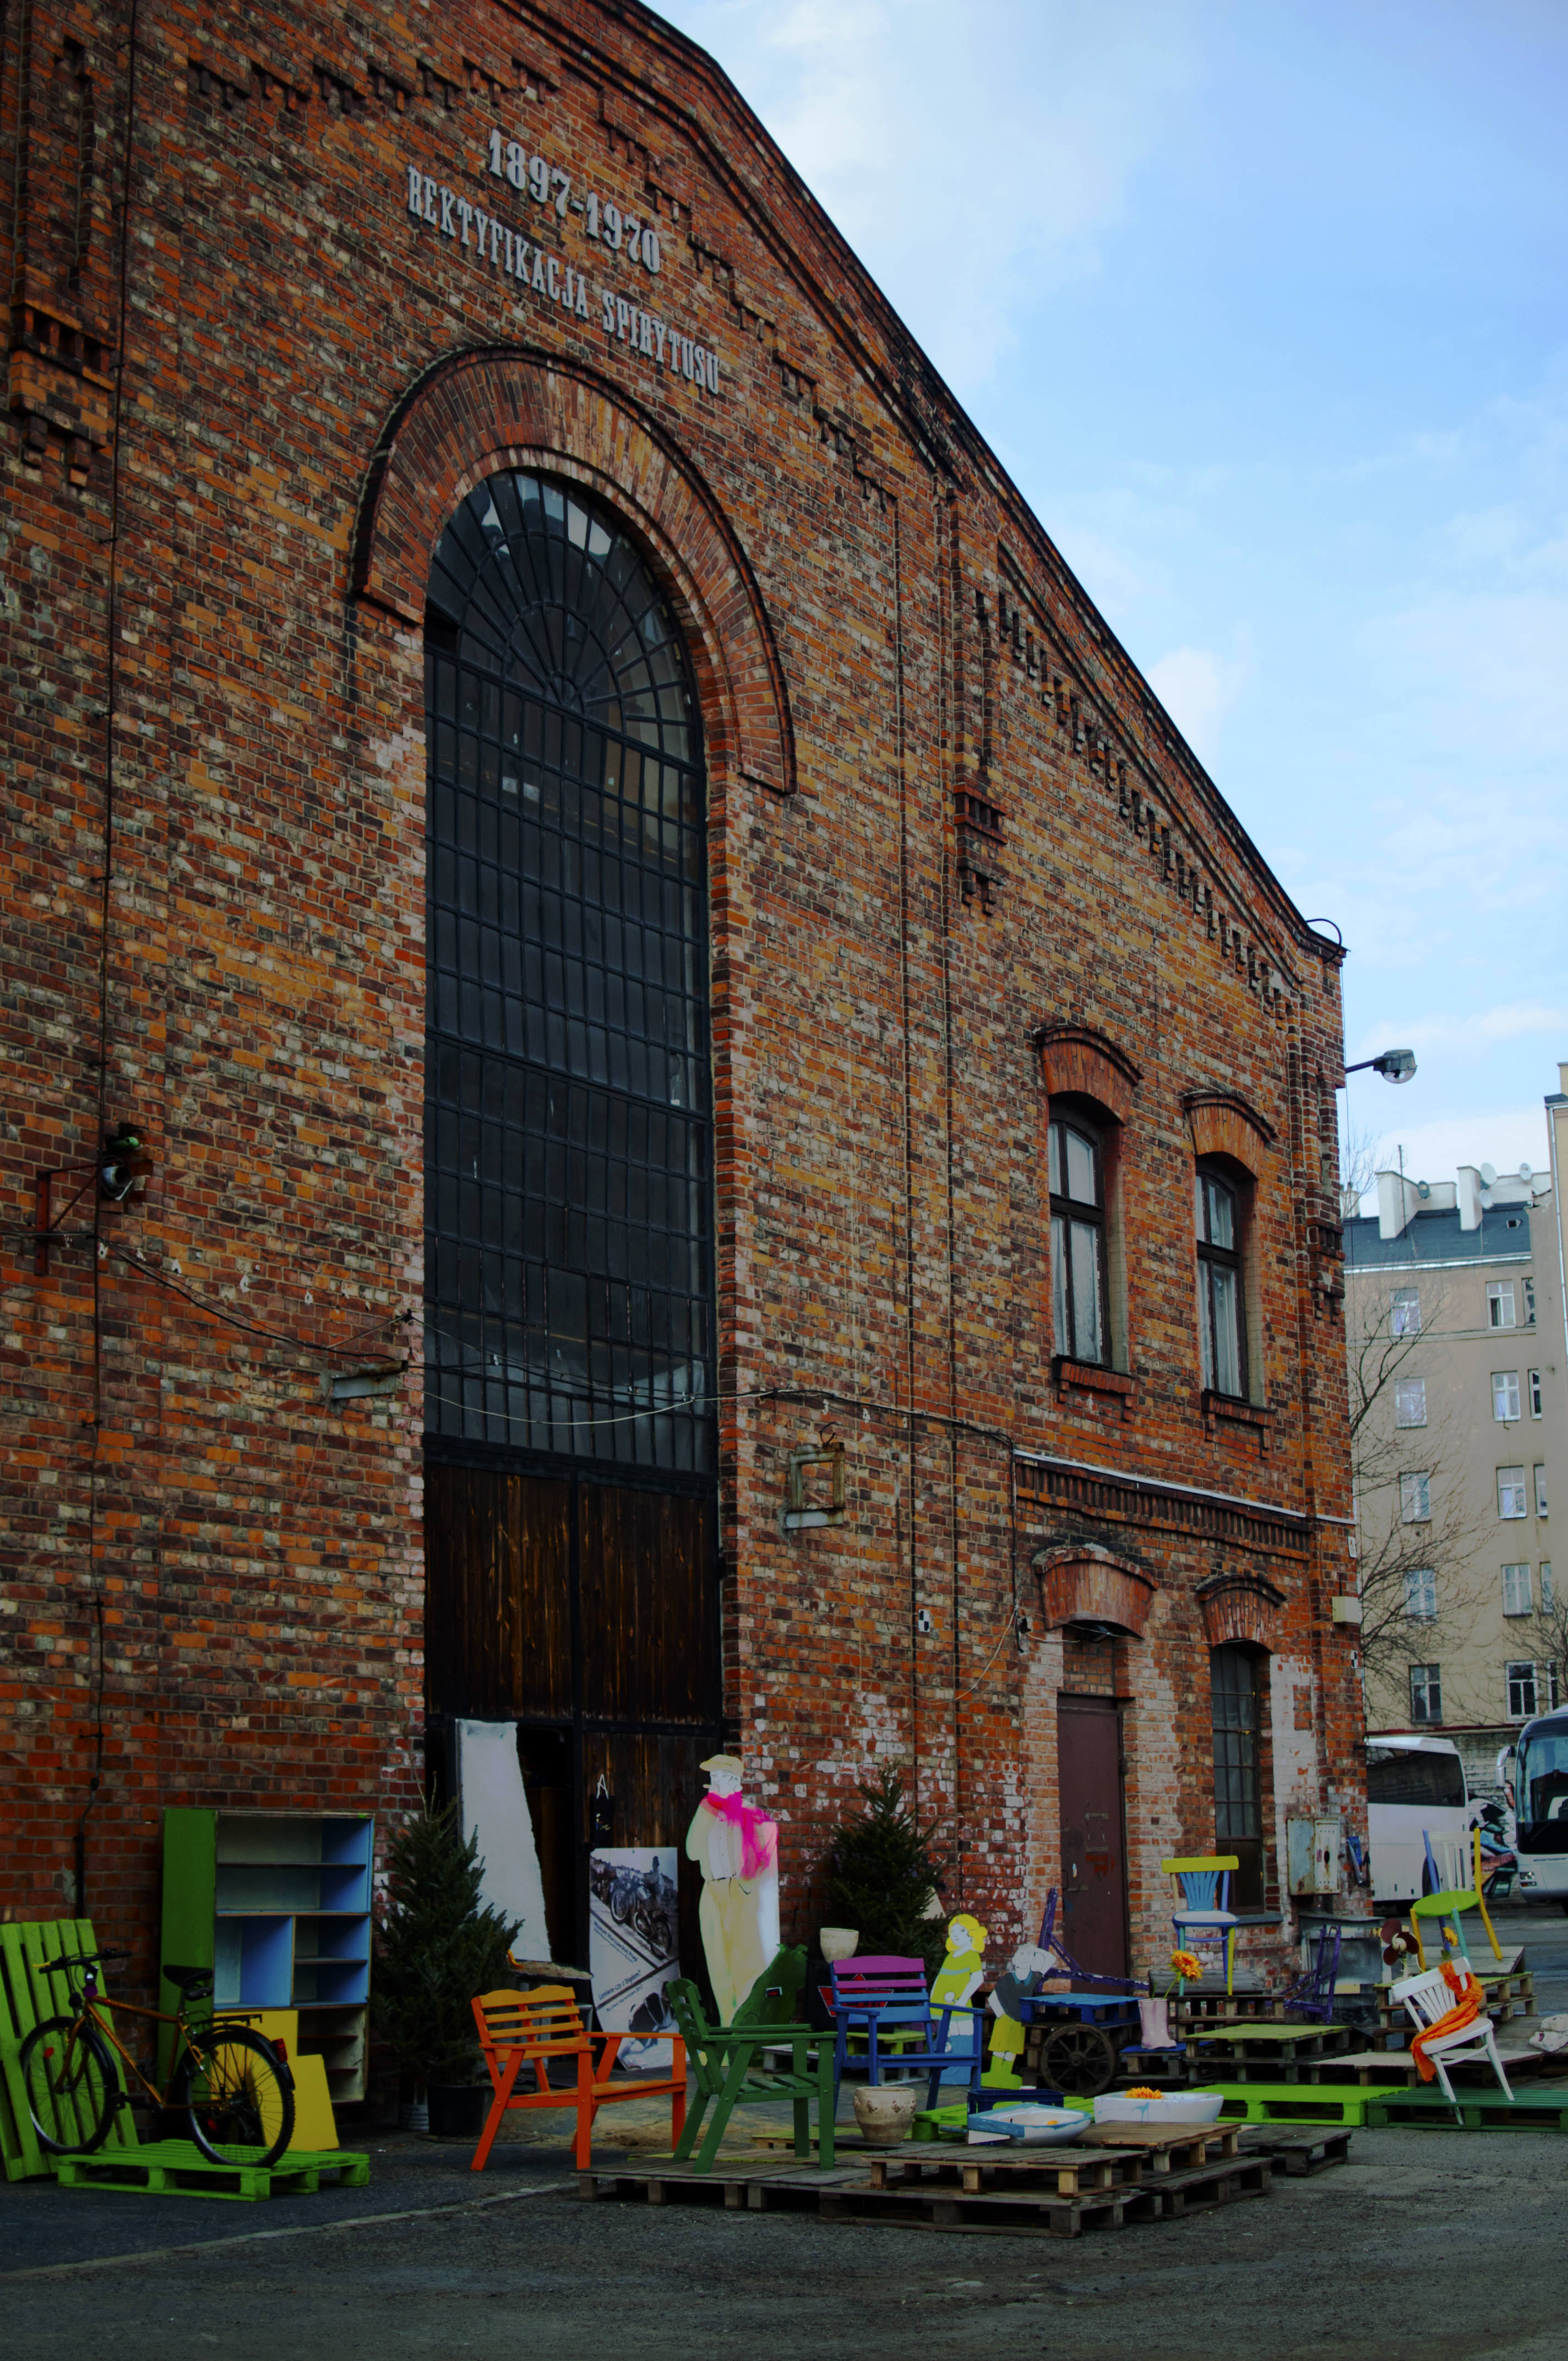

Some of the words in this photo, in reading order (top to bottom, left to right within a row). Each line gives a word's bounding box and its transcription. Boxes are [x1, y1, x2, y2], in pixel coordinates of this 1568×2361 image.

[407, 165, 590, 319] REKTYFIKACJA
[601, 289, 719, 395] SPIRYTUSU
[488, 129, 660, 274] 1897-1970
